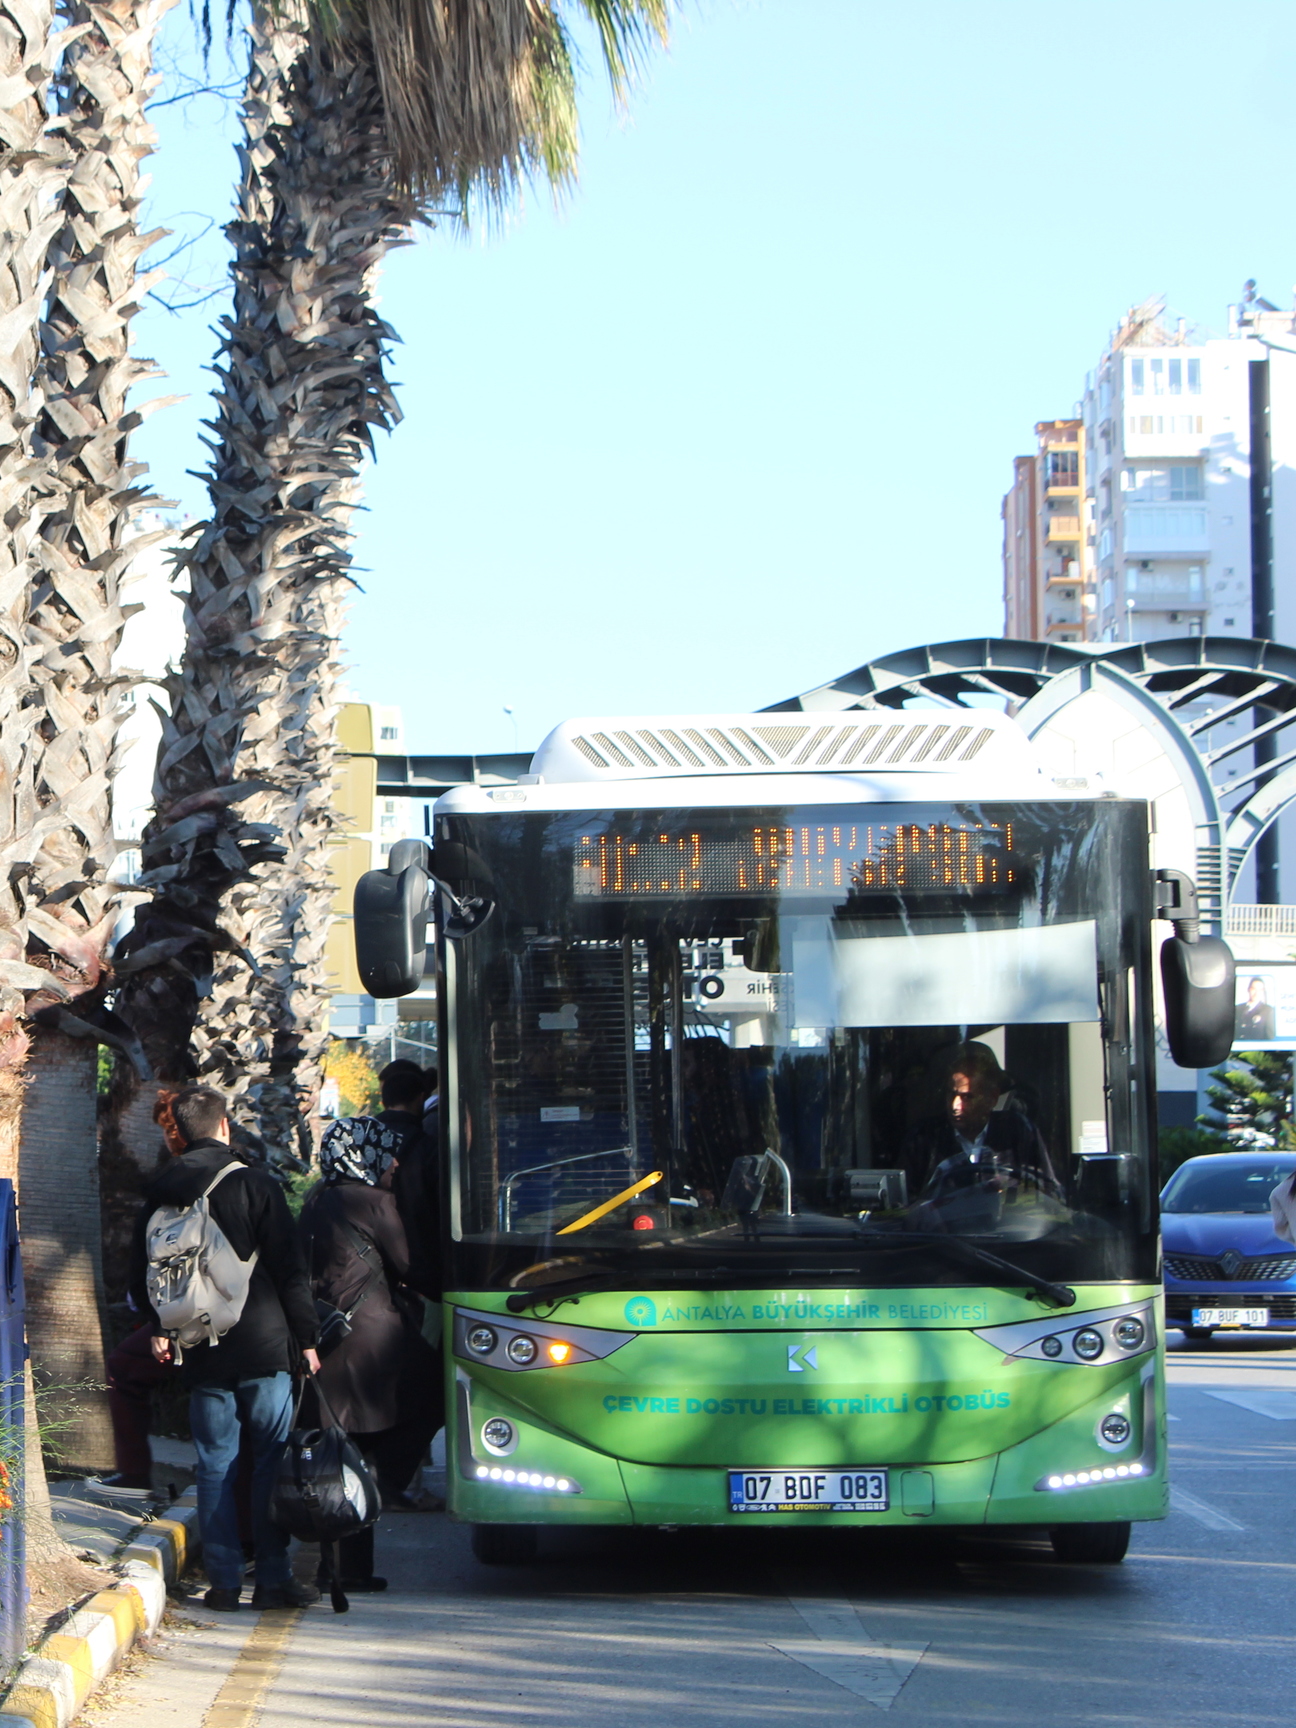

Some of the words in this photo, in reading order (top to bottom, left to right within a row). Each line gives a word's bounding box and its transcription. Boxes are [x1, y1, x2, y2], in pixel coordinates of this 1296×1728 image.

[661, 1304, 746, 1322] ANTALYA
[752, 1300, 881, 1322] BÜYÜKŞEHİR
[888, 1302, 988, 1321] BELEDİYESİ
[1200, 1310, 1213, 1321] 07
[1245, 1310, 1264, 1321] 101
[603, 1395, 681, 1416] ÇEVRE
[686, 1397, 767, 1415] DOSTU
[772, 1393, 908, 1415] ELEKTRİKLİ
[913, 1389, 1011, 1413] OTOBÜS
[744, 1476, 772, 1500] 07
[784, 1475, 826, 1500] BDF
[840, 1475, 883, 1499] 083
